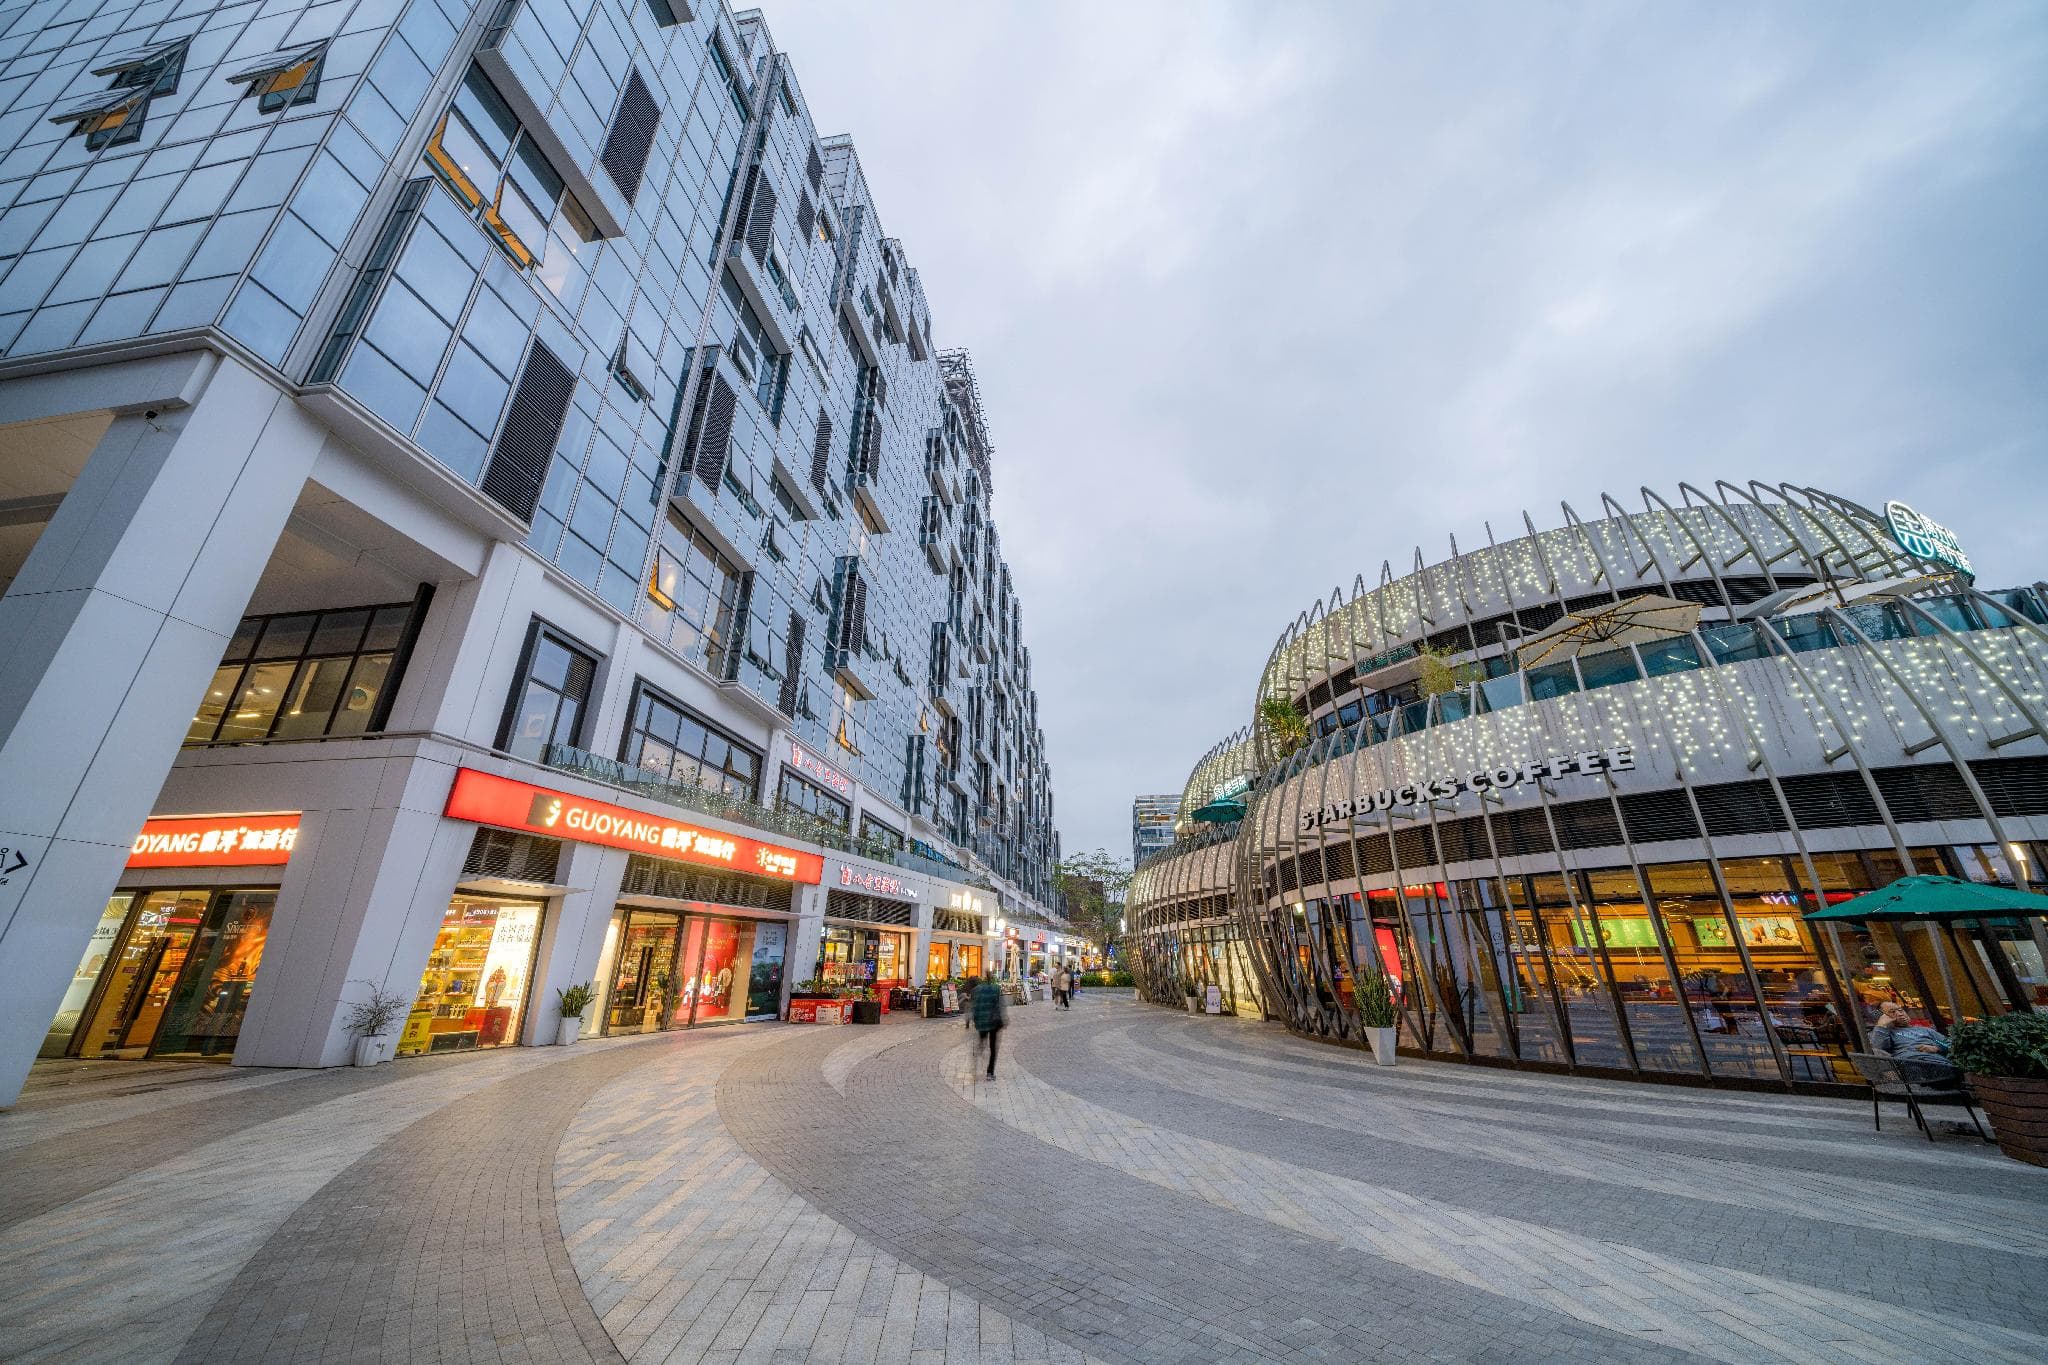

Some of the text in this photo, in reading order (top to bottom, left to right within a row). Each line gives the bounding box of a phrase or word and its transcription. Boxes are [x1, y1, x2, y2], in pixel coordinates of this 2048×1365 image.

[1299, 775, 1458, 831] STARBUCKS
[1464, 746, 1635, 794] COFFEE
[565, 807, 660, 844] GUOYANG
